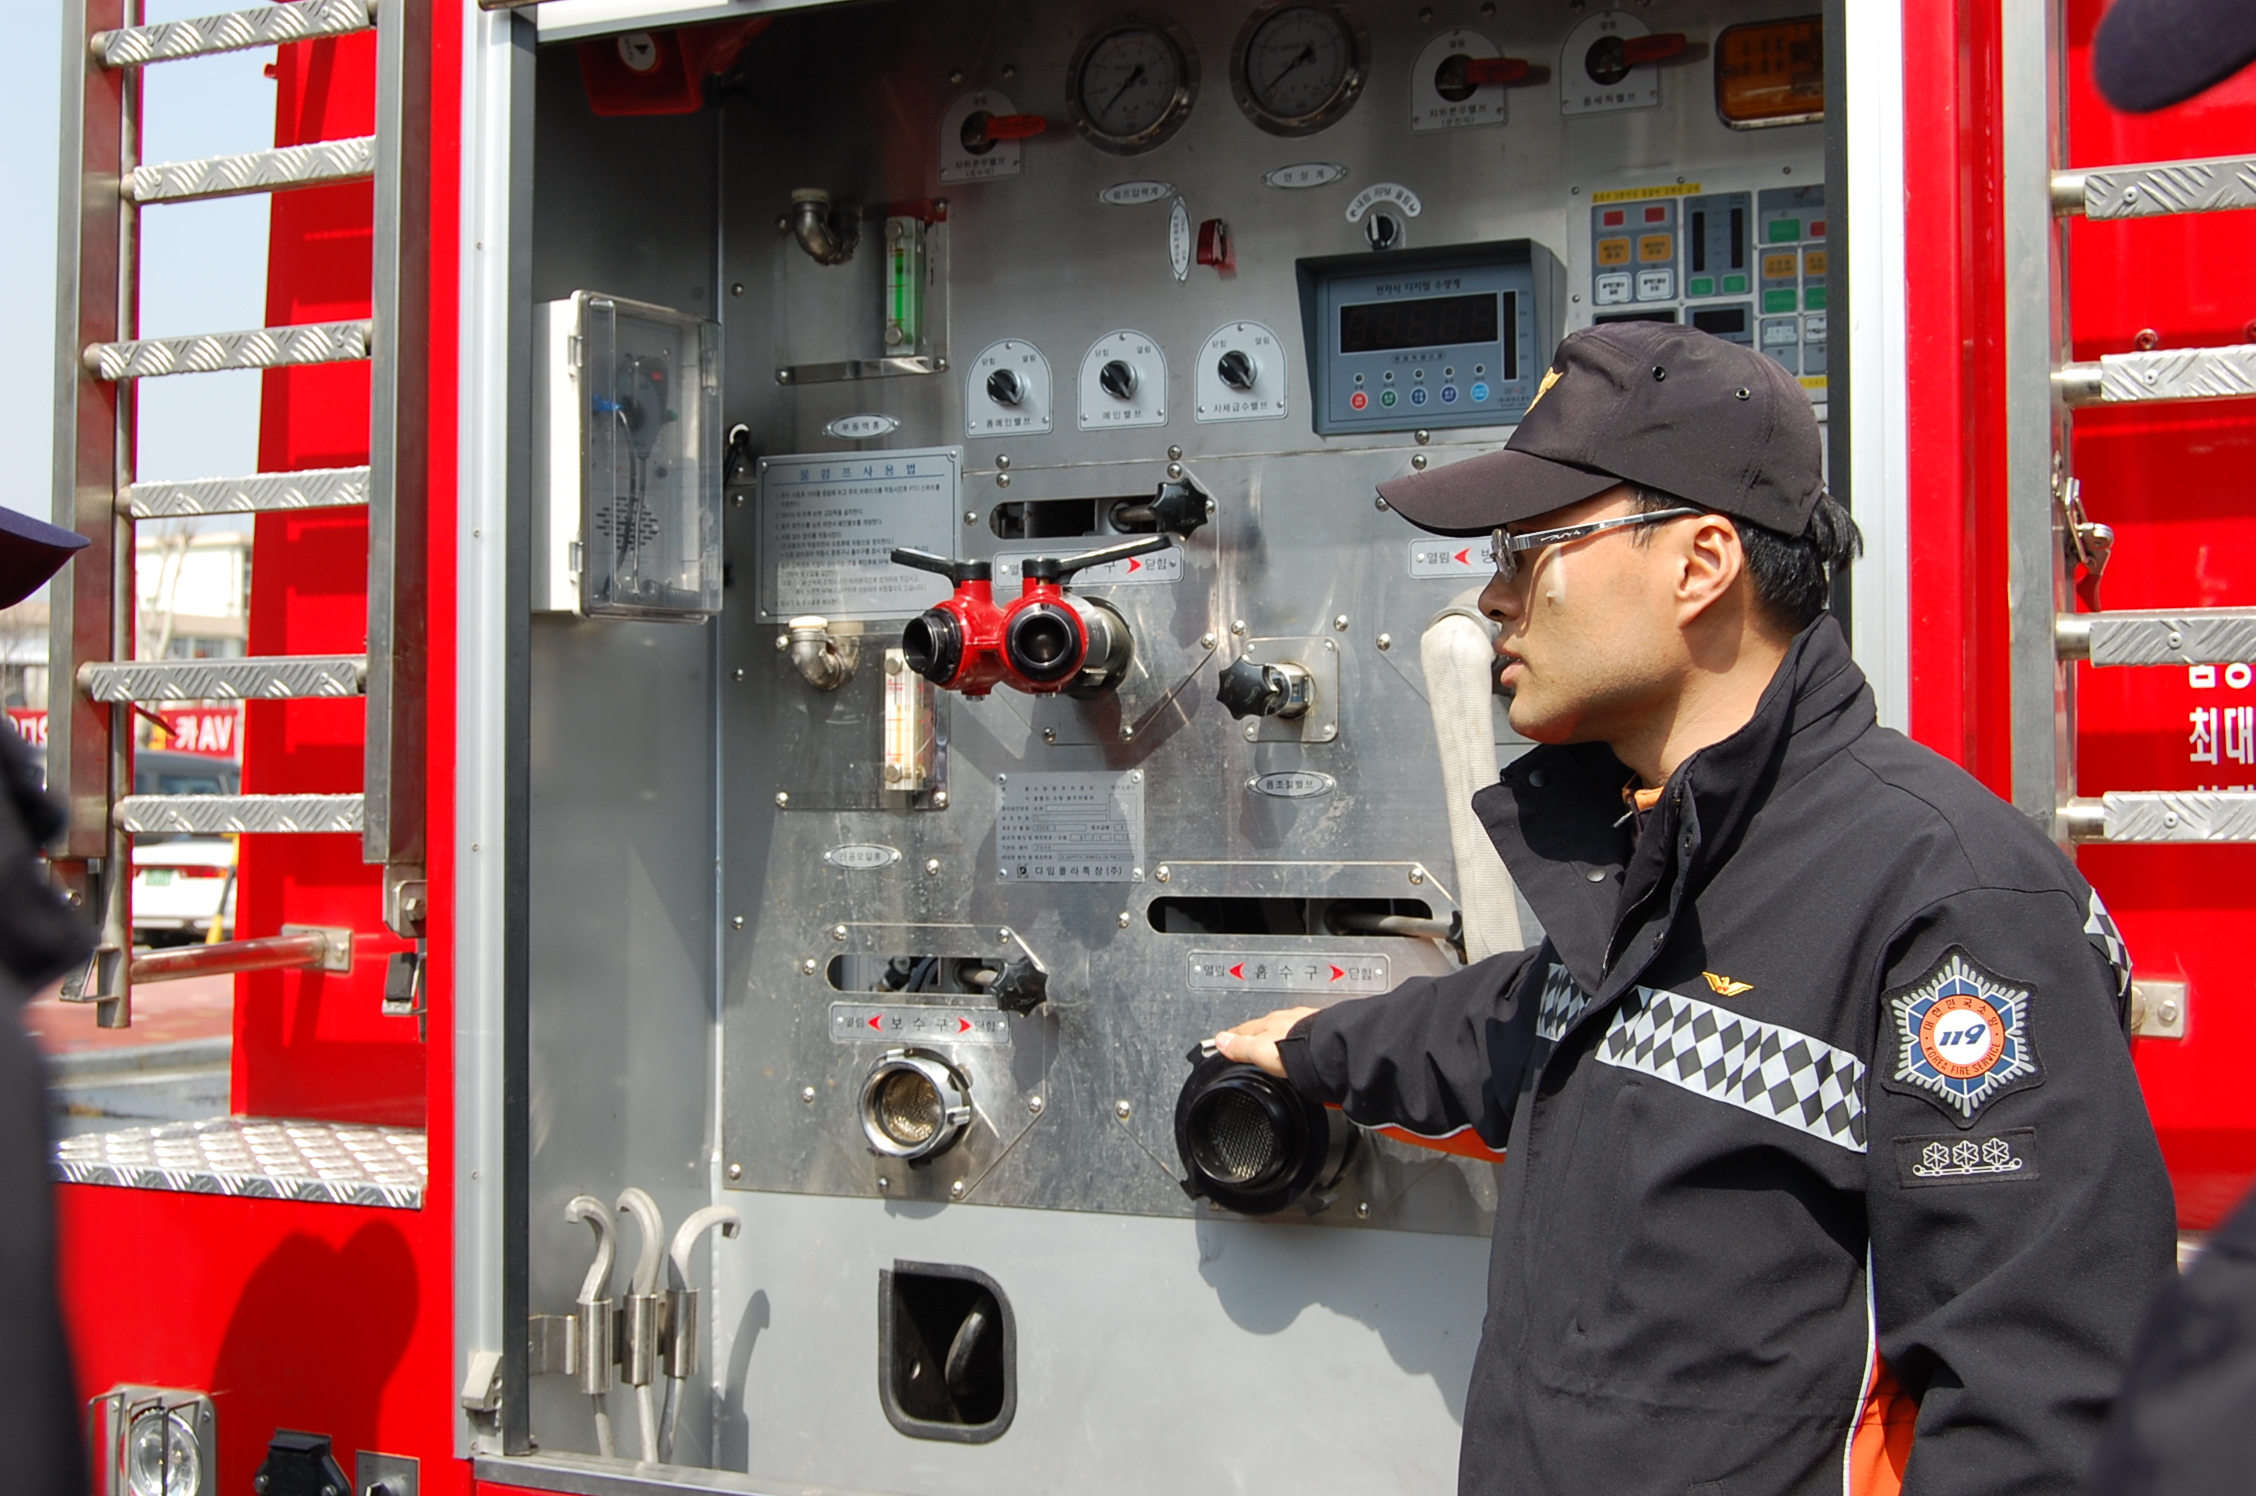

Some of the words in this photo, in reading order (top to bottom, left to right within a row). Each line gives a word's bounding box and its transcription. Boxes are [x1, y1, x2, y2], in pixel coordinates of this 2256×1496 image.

[1374, 186, 1391, 197] RPM
[1405, 279, 1431, 292] 디지털
[1103, 409, 1142, 420] 메인밸브
[1145, 557, 1167, 571] 닫힘
[1427, 551, 1450, 564] 열림
[2189, 706, 2254, 765] 최대
[1266, 780, 1314, 790] 폼조절밸브
[1203, 964, 1225, 977] 열림
[1254, 964, 1318, 980] 흡수구
[1348, 967, 1372, 981] 닫힘
[891, 1016, 948, 1032] 보수구
[1939, 1023, 1986, 1046] 119
[1925, 1046, 1947, 1071] KOREA
[1950, 1065, 1970, 1075] FIRE
[1972, 1043, 2001, 1073] SERVICE
